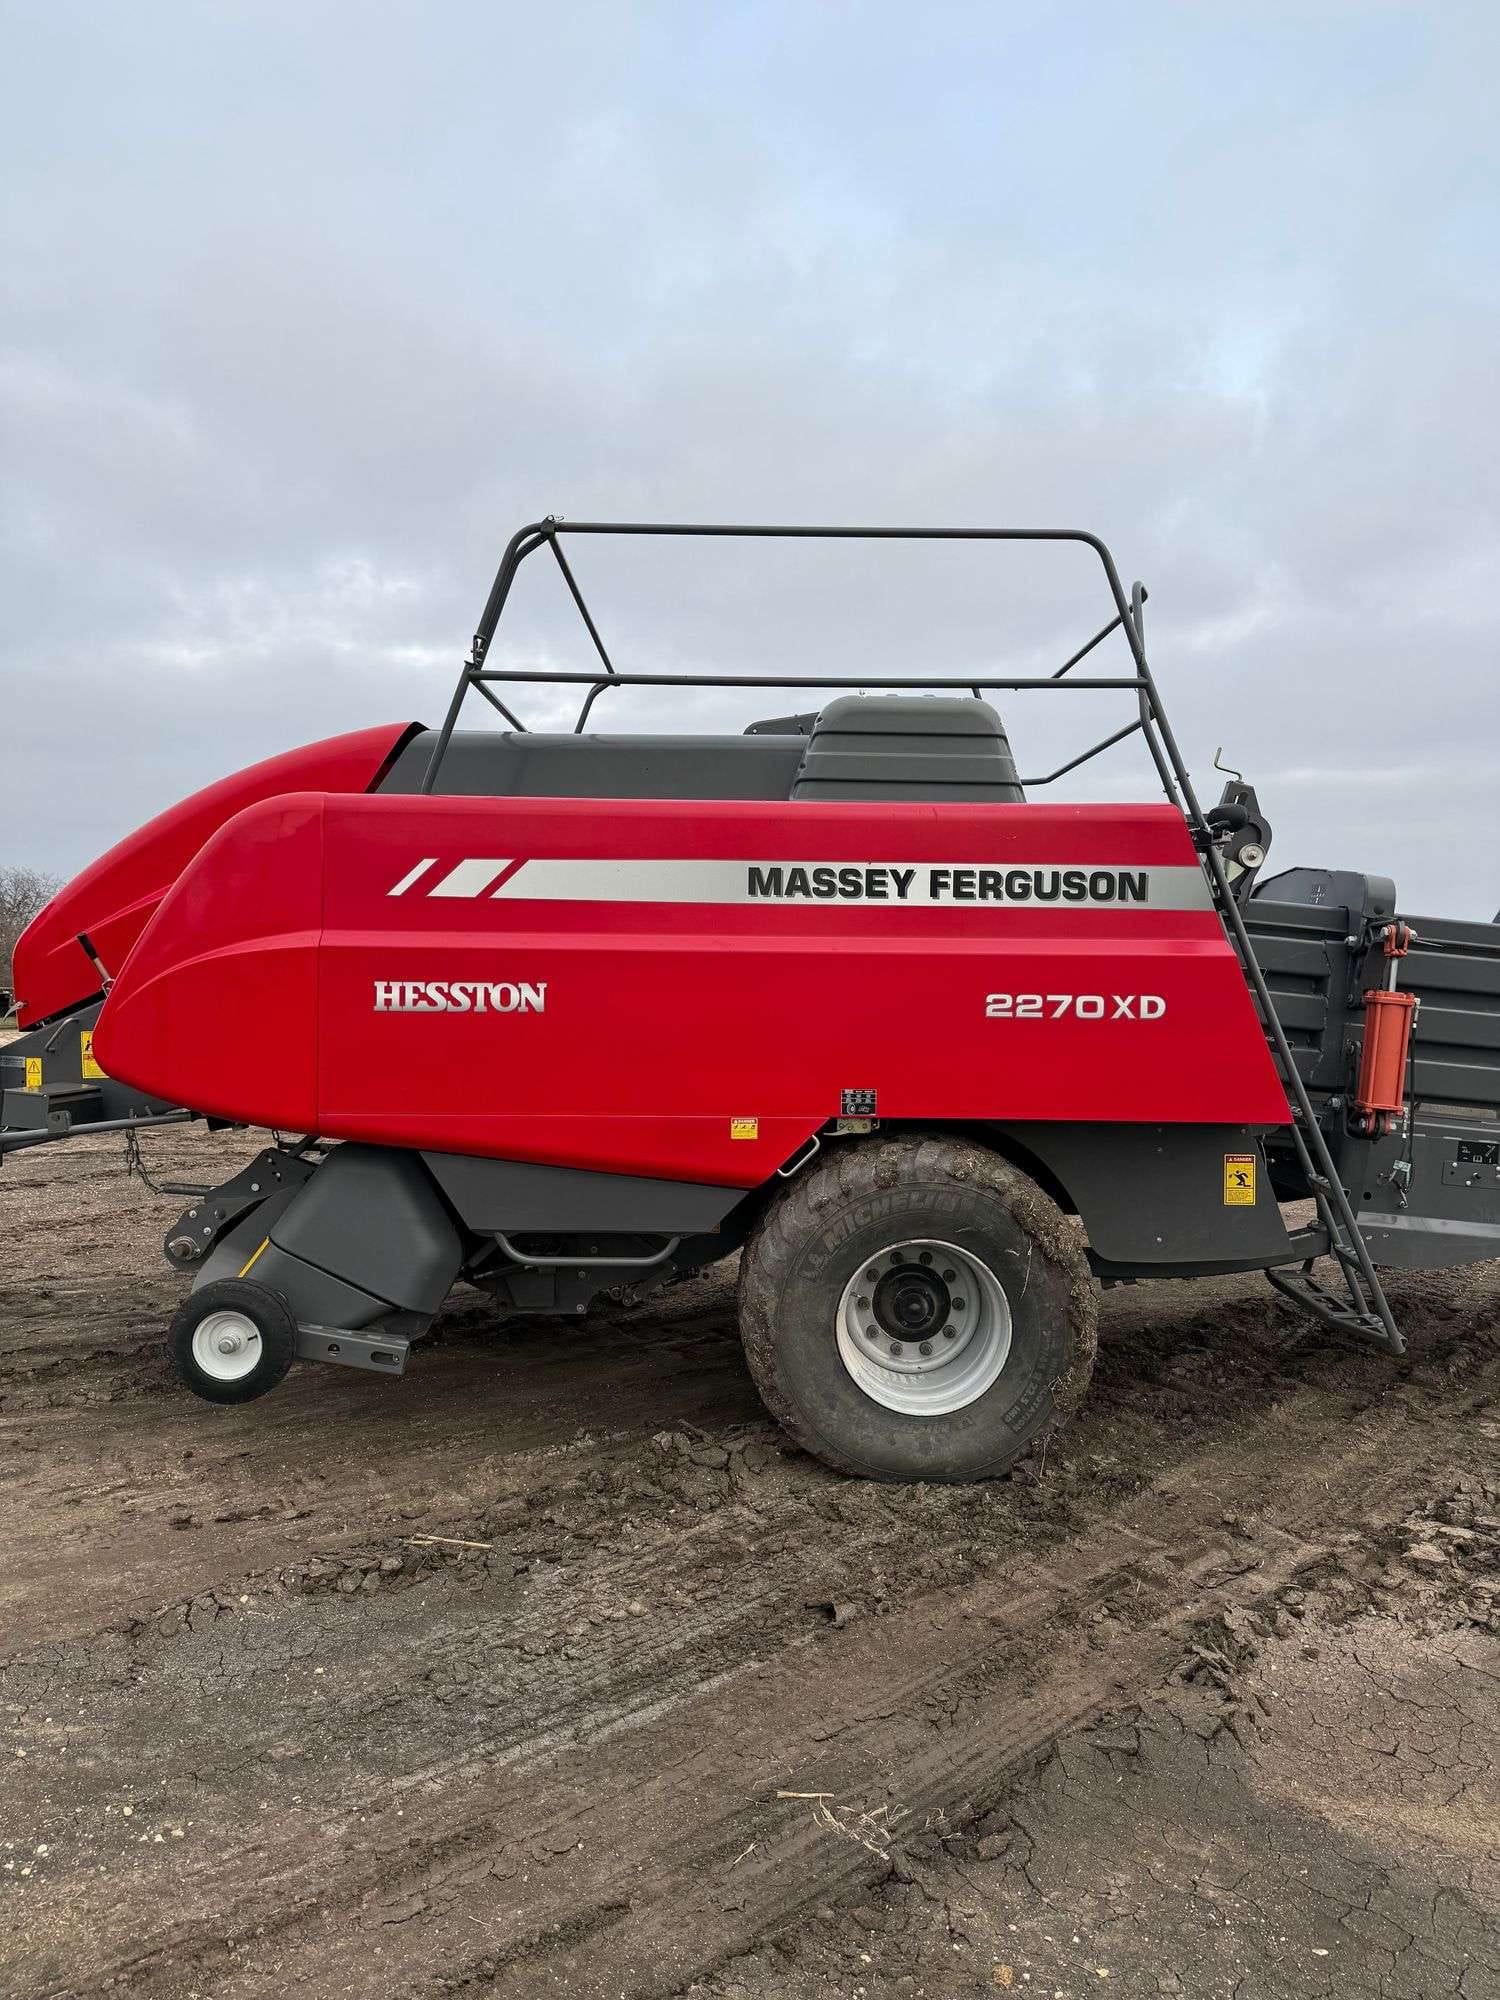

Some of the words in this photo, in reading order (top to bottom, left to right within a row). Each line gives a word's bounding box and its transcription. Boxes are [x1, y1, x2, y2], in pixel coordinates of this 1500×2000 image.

[747, 866, 916, 900] MASSEY
[929, 869, 1150, 903] FERGUSON
[373, 980, 547, 1013] HESSTON
[985, 993, 1104, 1019] 2270
[1111, 995, 1166, 1019] XD
[821, 1190, 963, 1252] MICHELIN
